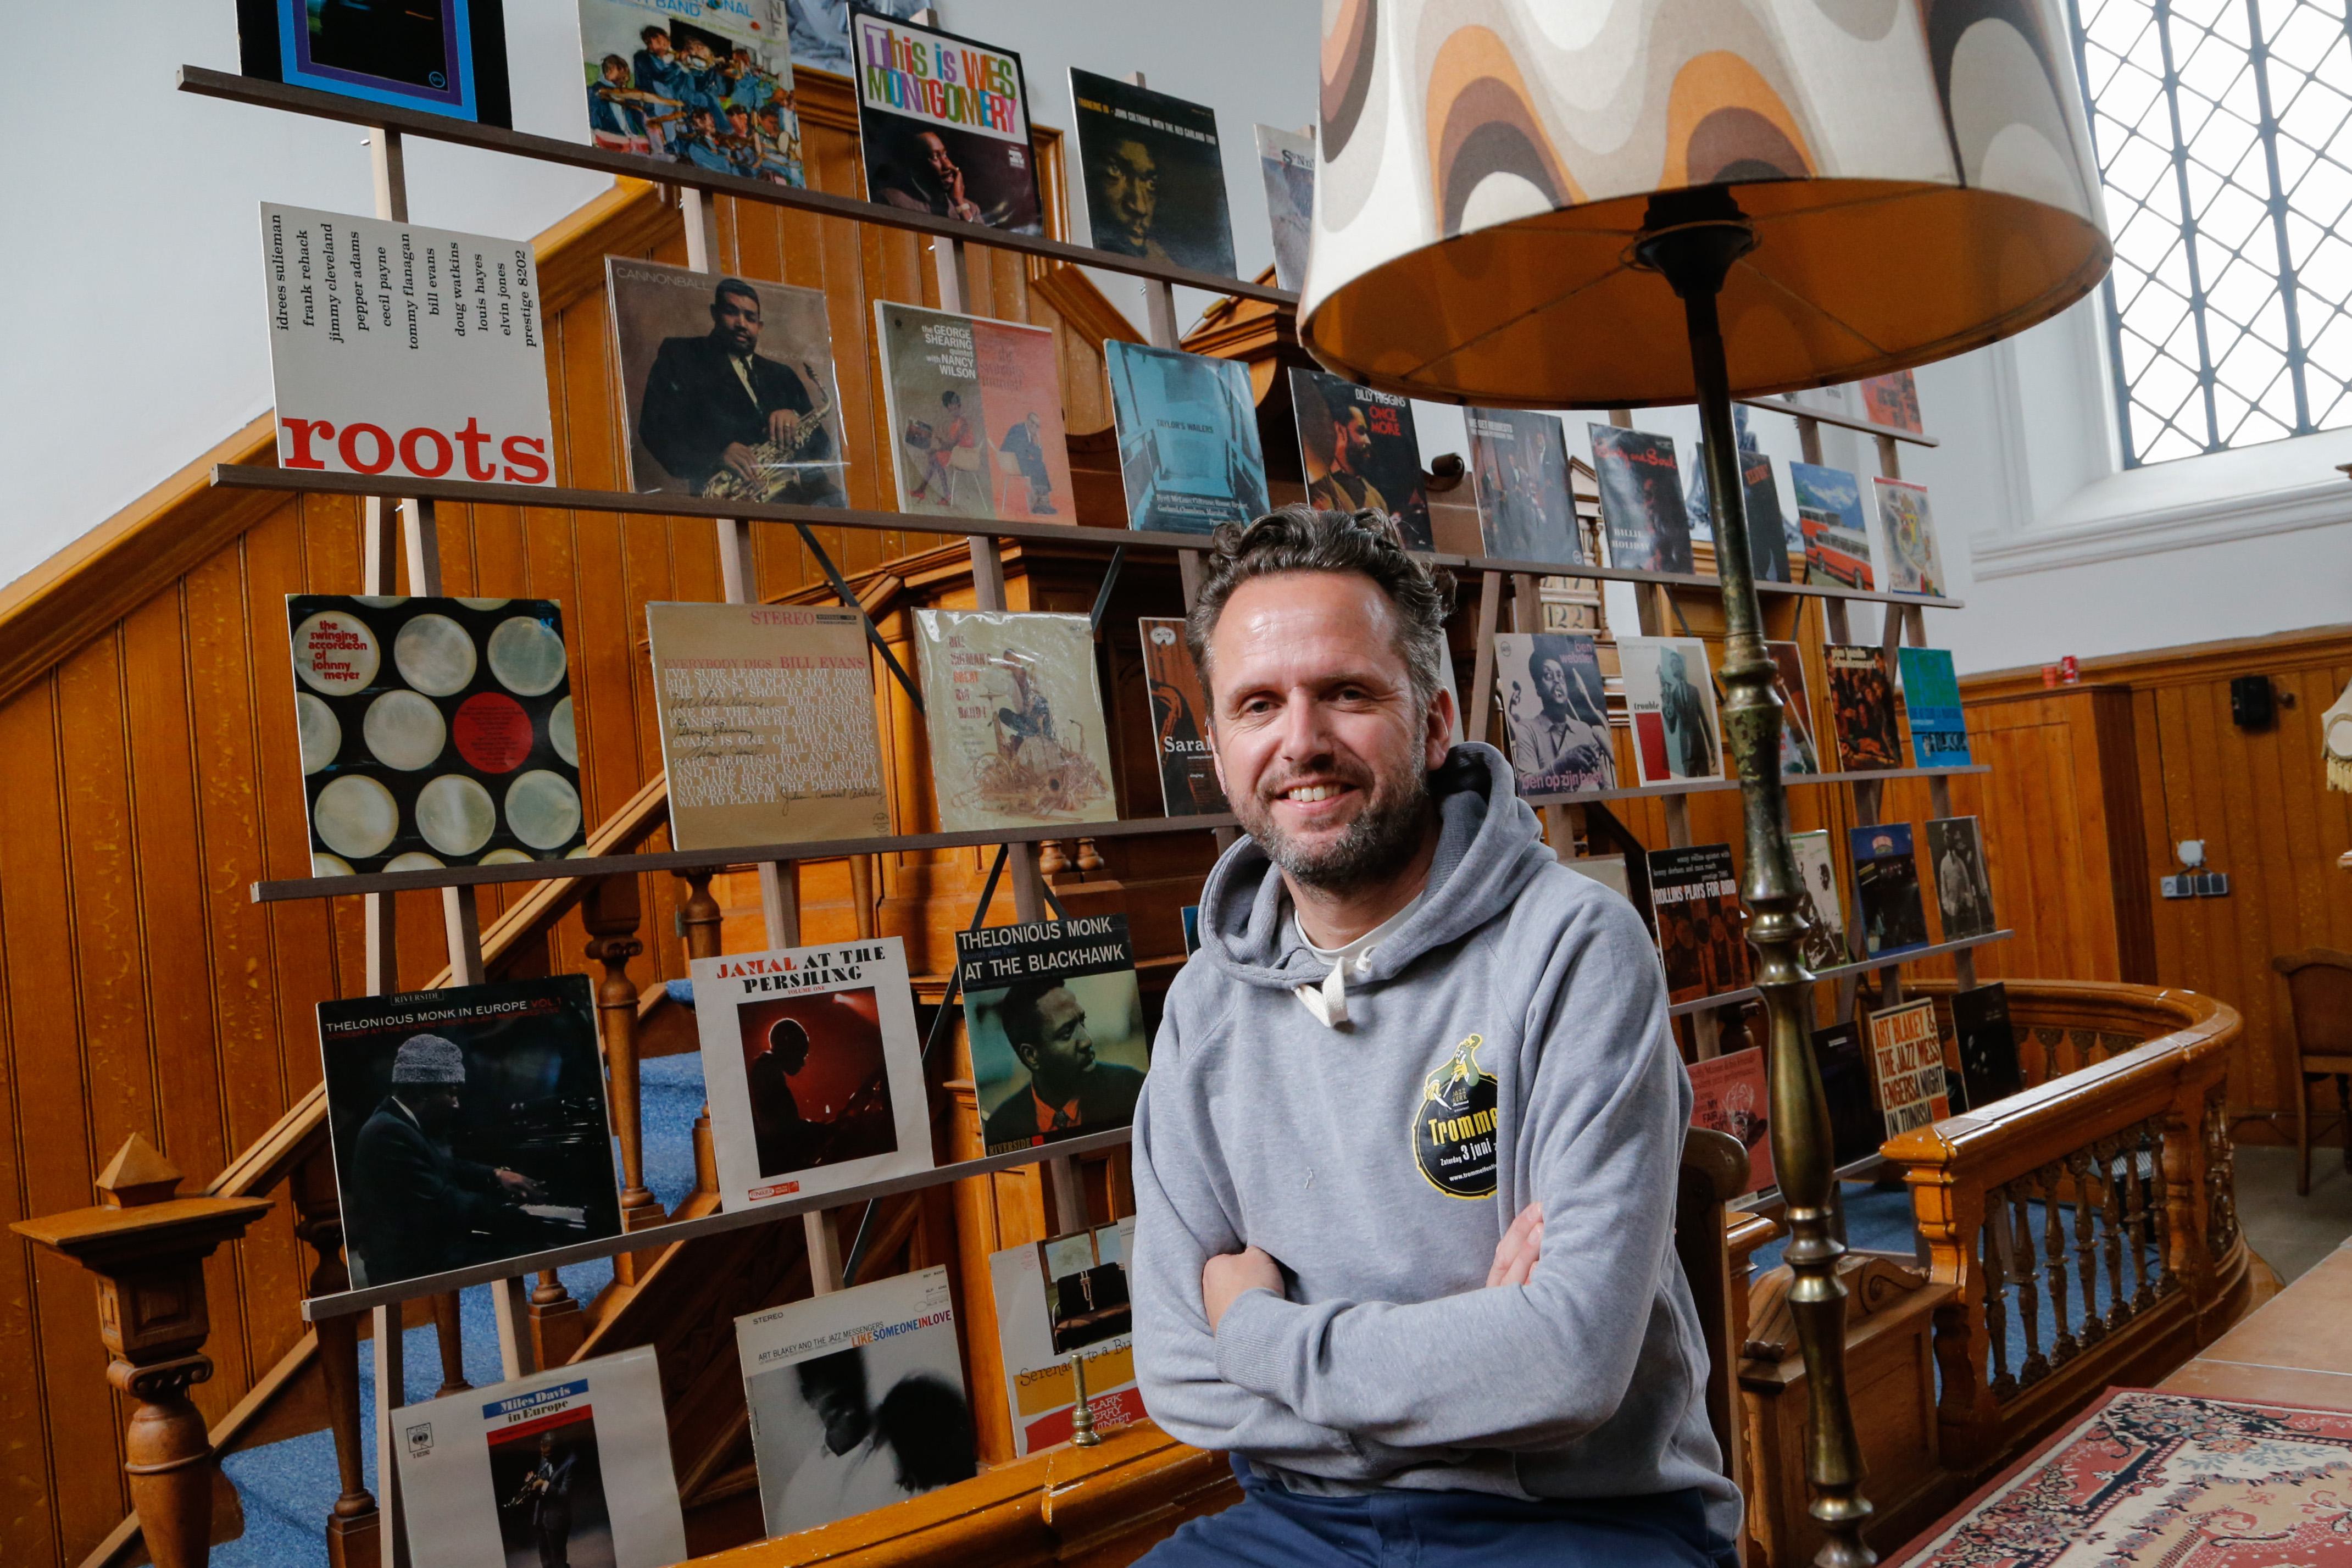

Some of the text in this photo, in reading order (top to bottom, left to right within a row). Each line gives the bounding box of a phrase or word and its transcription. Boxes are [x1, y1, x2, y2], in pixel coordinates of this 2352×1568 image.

[961, 49, 1016, 100] WES
[866, 64, 1016, 134] MONTGOMERY
[272, 215, 289, 331] idrees sulieman
[297, 230, 314, 327] frank rehack
[321, 223, 344, 343] jimmy cleveland
[351, 231, 369, 331] pepper adams
[427, 248, 440, 315] bill evans
[616, 266, 716, 291] CANNONBALL
[377, 247, 392, 327] cecil payne
[402, 233, 418, 350] tommy flanagan
[449, 242, 466, 336] doug watkins
[475, 254, 488, 331] louis hayes
[498, 263, 510, 335] elvin jones
[515, 251, 537, 348] prestige 8202
[925, 333, 972, 350] SHEARING
[934, 325, 971, 340] GEORGE
[939, 365, 976, 379] WILSON
[942, 354, 974, 368] NANCY
[1187, 422, 1214, 433] WAILERS
[1371, 421, 1402, 436] MORE
[281, 417, 549, 484] roots
[319, 620, 338, 630] the
[751, 611, 815, 625] STEREO
[1548, 605, 1584, 627] 122
[308, 642, 368, 650] accordeon
[310, 630, 358, 642] swinging
[1575, 640, 1592, 653] ben
[313, 660, 351, 671] johnny
[315, 649, 326, 660] of
[664, 657, 865, 669] EVERYBODY DIGS BILL EVANS
[1559, 651, 1593, 664] webster
[324, 672, 360, 682] meyer
[665, 668, 866, 679] I'VE SURE LEARNED A LOT FROM
[668, 705, 870, 718] ONE OF THE MOST REFRESHING
[788, 697, 870, 706] BILL EVANS IS
[1634, 701, 1660, 710] trouble
[781, 742, 875, 753] BILL EVANS HAS
[677, 779, 879, 797] NUMBER SEEM THE DEFINITIVE
[1545, 775, 1560, 791] op
[1562, 770, 1579, 792] zijn
[1654, 886, 1684, 905] ROLLINS
[1684, 883, 1705, 900] PLAYS
[1706, 881, 1720, 897] FOR
[959, 916, 1112, 950] THELONIOUS MONK
[717, 946, 886, 978] JAMAL AT THE
[965, 961, 983, 981] AT
[989, 957, 1022, 977] THE
[1028, 944, 1125, 972] BLACKHAWK
[742, 965, 863, 993] PERSHING
[394, 992, 440, 1003] RIVERSIDE
[326, 1014, 414, 1032] THELONIOUS
[418, 1009, 456, 1021] MONK
[459, 1007, 471, 1016] IN
[476, 1000, 527, 1015] EUROPE
[1874, 1006, 1936, 1049] ART BLAKEY &
[1877, 1036, 1940, 1078] THE JAZZ MESS
[1453, 1088, 1466, 1096] JAZZ
[1882, 1075, 1917, 1110] ENGERS
[1428, 1108, 1498, 1147] Tromme
[988, 1138, 1031, 1155] RIVERSIDE
[1461, 1145, 1470, 1160] 3
[1470, 1138, 1492, 1160] juni
[1449, 1164, 1497, 1181] www.trommelfestiv
[753, 1311, 784, 1324] STEREO
[758, 1321, 884, 1361] ART BLAKEY AND THE JAZZ MESSENGERS
[1020, 1339, 1132, 1386] Serena to a Bu
[501, 1387, 570, 1413] Miles Davis
[508, 1400, 568, 1423] in Europe
[1093, 1404, 1122, 1421] ERRY
